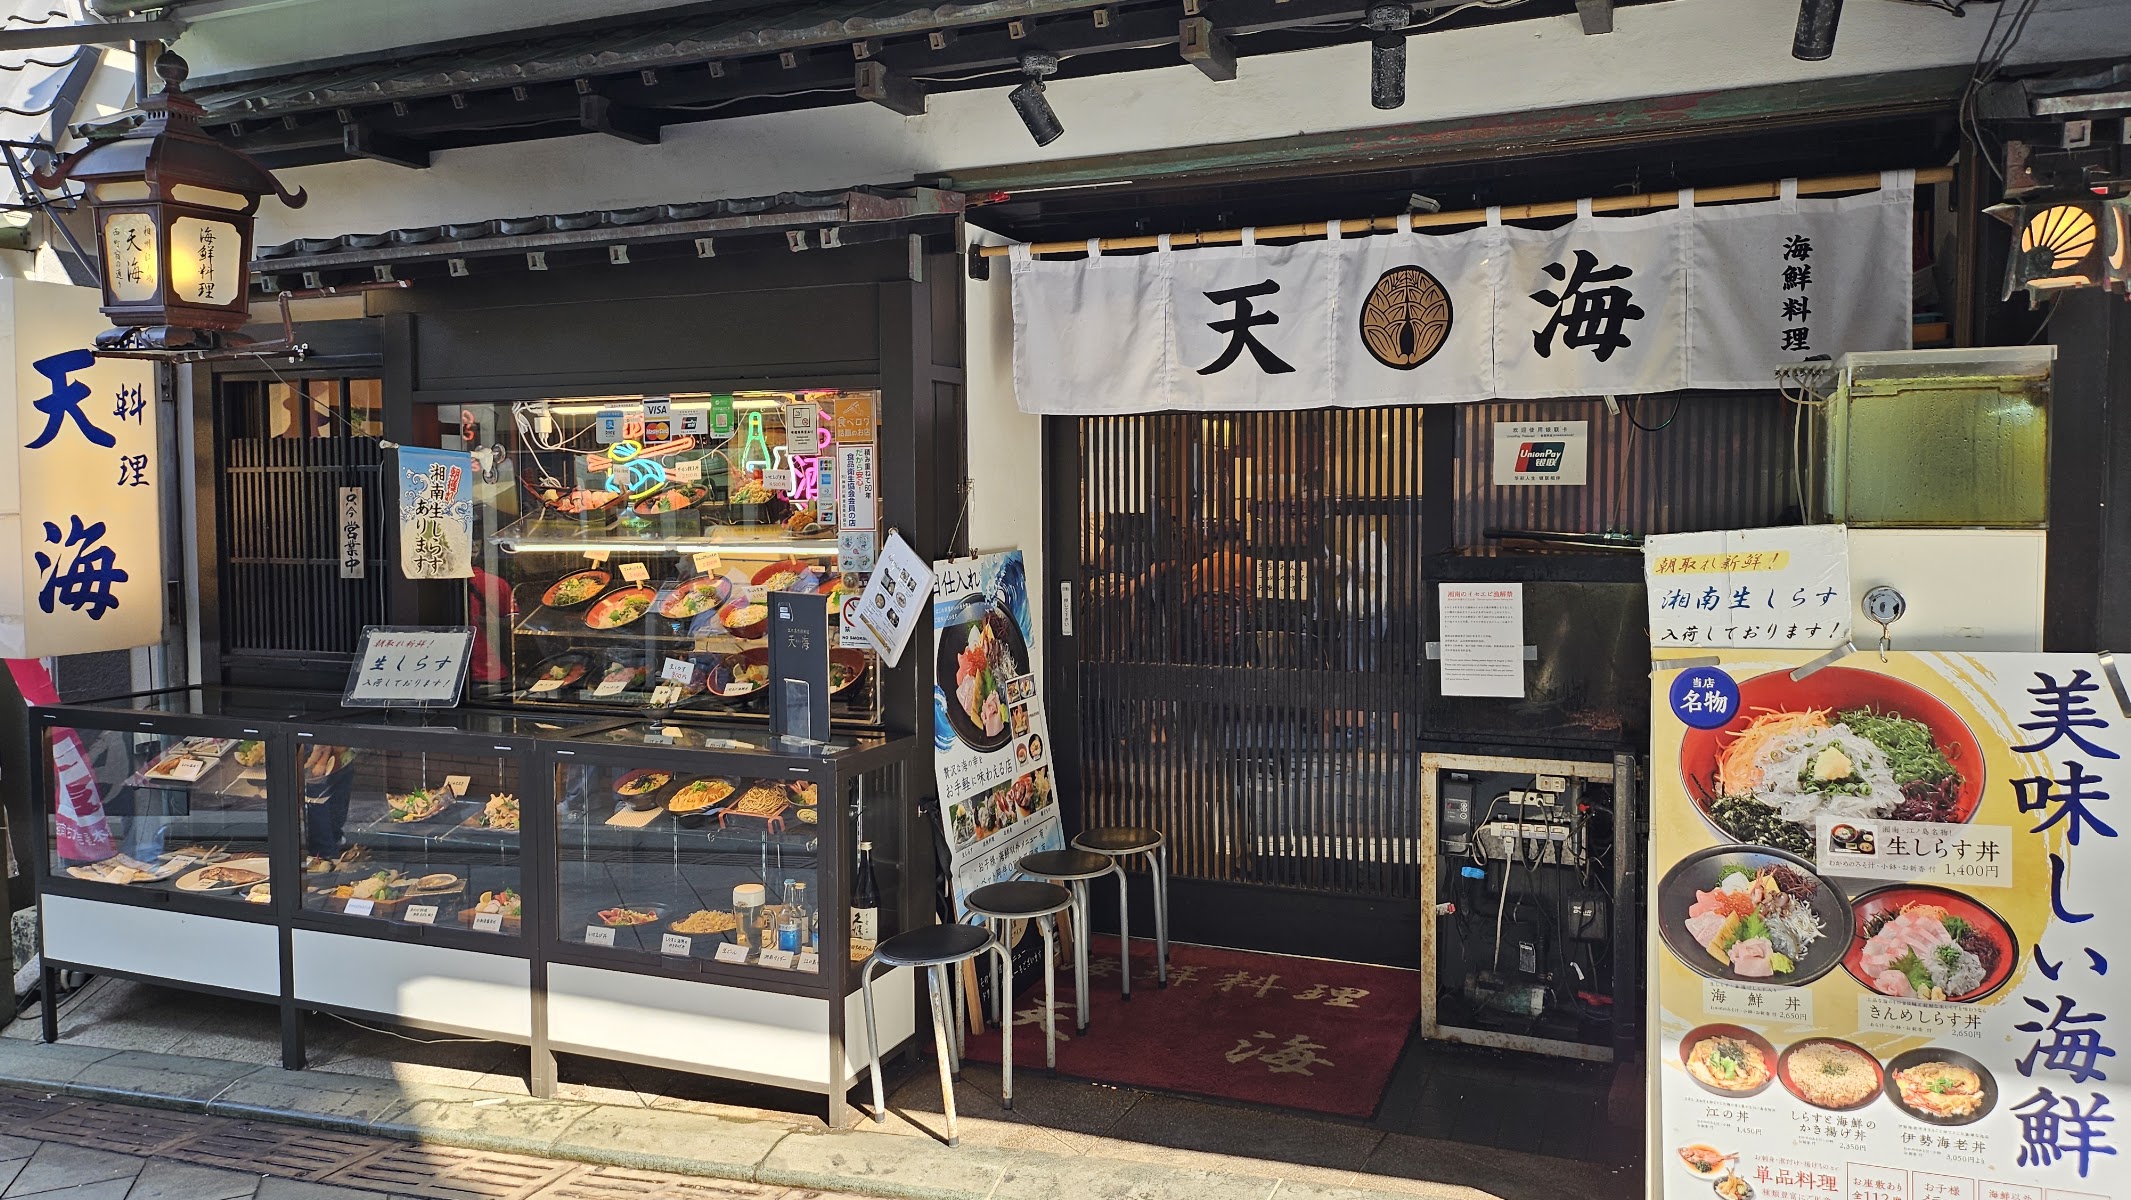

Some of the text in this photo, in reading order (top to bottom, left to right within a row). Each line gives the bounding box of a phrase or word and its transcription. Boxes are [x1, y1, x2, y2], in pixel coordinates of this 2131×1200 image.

[126, 228, 144, 284] 天海
[197, 226, 217, 299] 海鮮料理
[1781, 234, 1814, 352] 海鮮料理
[1196, 249, 1646, 376] 天 海
[647, 405, 667, 415] VISA
[838, 416, 871, 427] 食べログ
[112, 382, 150, 487] 料理
[838, 429, 871, 437] 話題のお店
[1520, 449, 1561, 460] UnionPay
[24, 349, 129, 621] 天海
[864, 448, 873, 500] 積み重ねて60年
[847, 453, 856, 527] 食品衛生協会会員の店
[429, 463, 446, 575] 湘南生しらす
[344, 493, 361, 574] 只今営業中
[414, 499, 430, 573] あります
[1655, 553, 1780, 574] 朝取れ新鮮！
[1447, 590, 1513, 598] 湘南のイセエビ漁解禁
[1661, 586, 1838, 611] 湘南生しらす
[1661, 621, 1841, 643] 入荷しております！
[369, 654, 452, 671] 生しらす
[1692, 676, 1715, 689] 当店
[1679, 689, 1729, 714] 名物
[946, 758, 1014, 799] お手軽に味わえる店
[1885, 835, 2001, 863] 生しらす丼
[1944, 863, 1999, 878] 1,400円
[2008, 669, 2122, 1178] 美味しい海鮮
[721, 947, 737, 955] 生ビール
[1711, 988, 1801, 1012] 海鮮丼
[1779, 1011, 1808, 1021] 2,650円
[1869, 1005, 1982, 1030] きんめしらす丼
[1951, 1029, 1981, 1039] 2,650円
[1223, 1029, 1336, 1079] 海
[1705, 1105, 1750, 1123] 江の丼
[1791, 1110, 1877, 1130] しらすと海鮮の
[1736, 1126, 1762, 1136] 1,450円
[1799, 1123, 1867, 1142] かき揚げ丼
[1900, 1131, 1987, 1155] 伊勢海老丼
[1945, 1153, 1985, 1165] 3,050円より
[1753, 1164, 1839, 1193] 単品料理
[1853, 1176, 1902, 1192] お座敷あり
[1924, 1181, 1960, 1197] お子様
